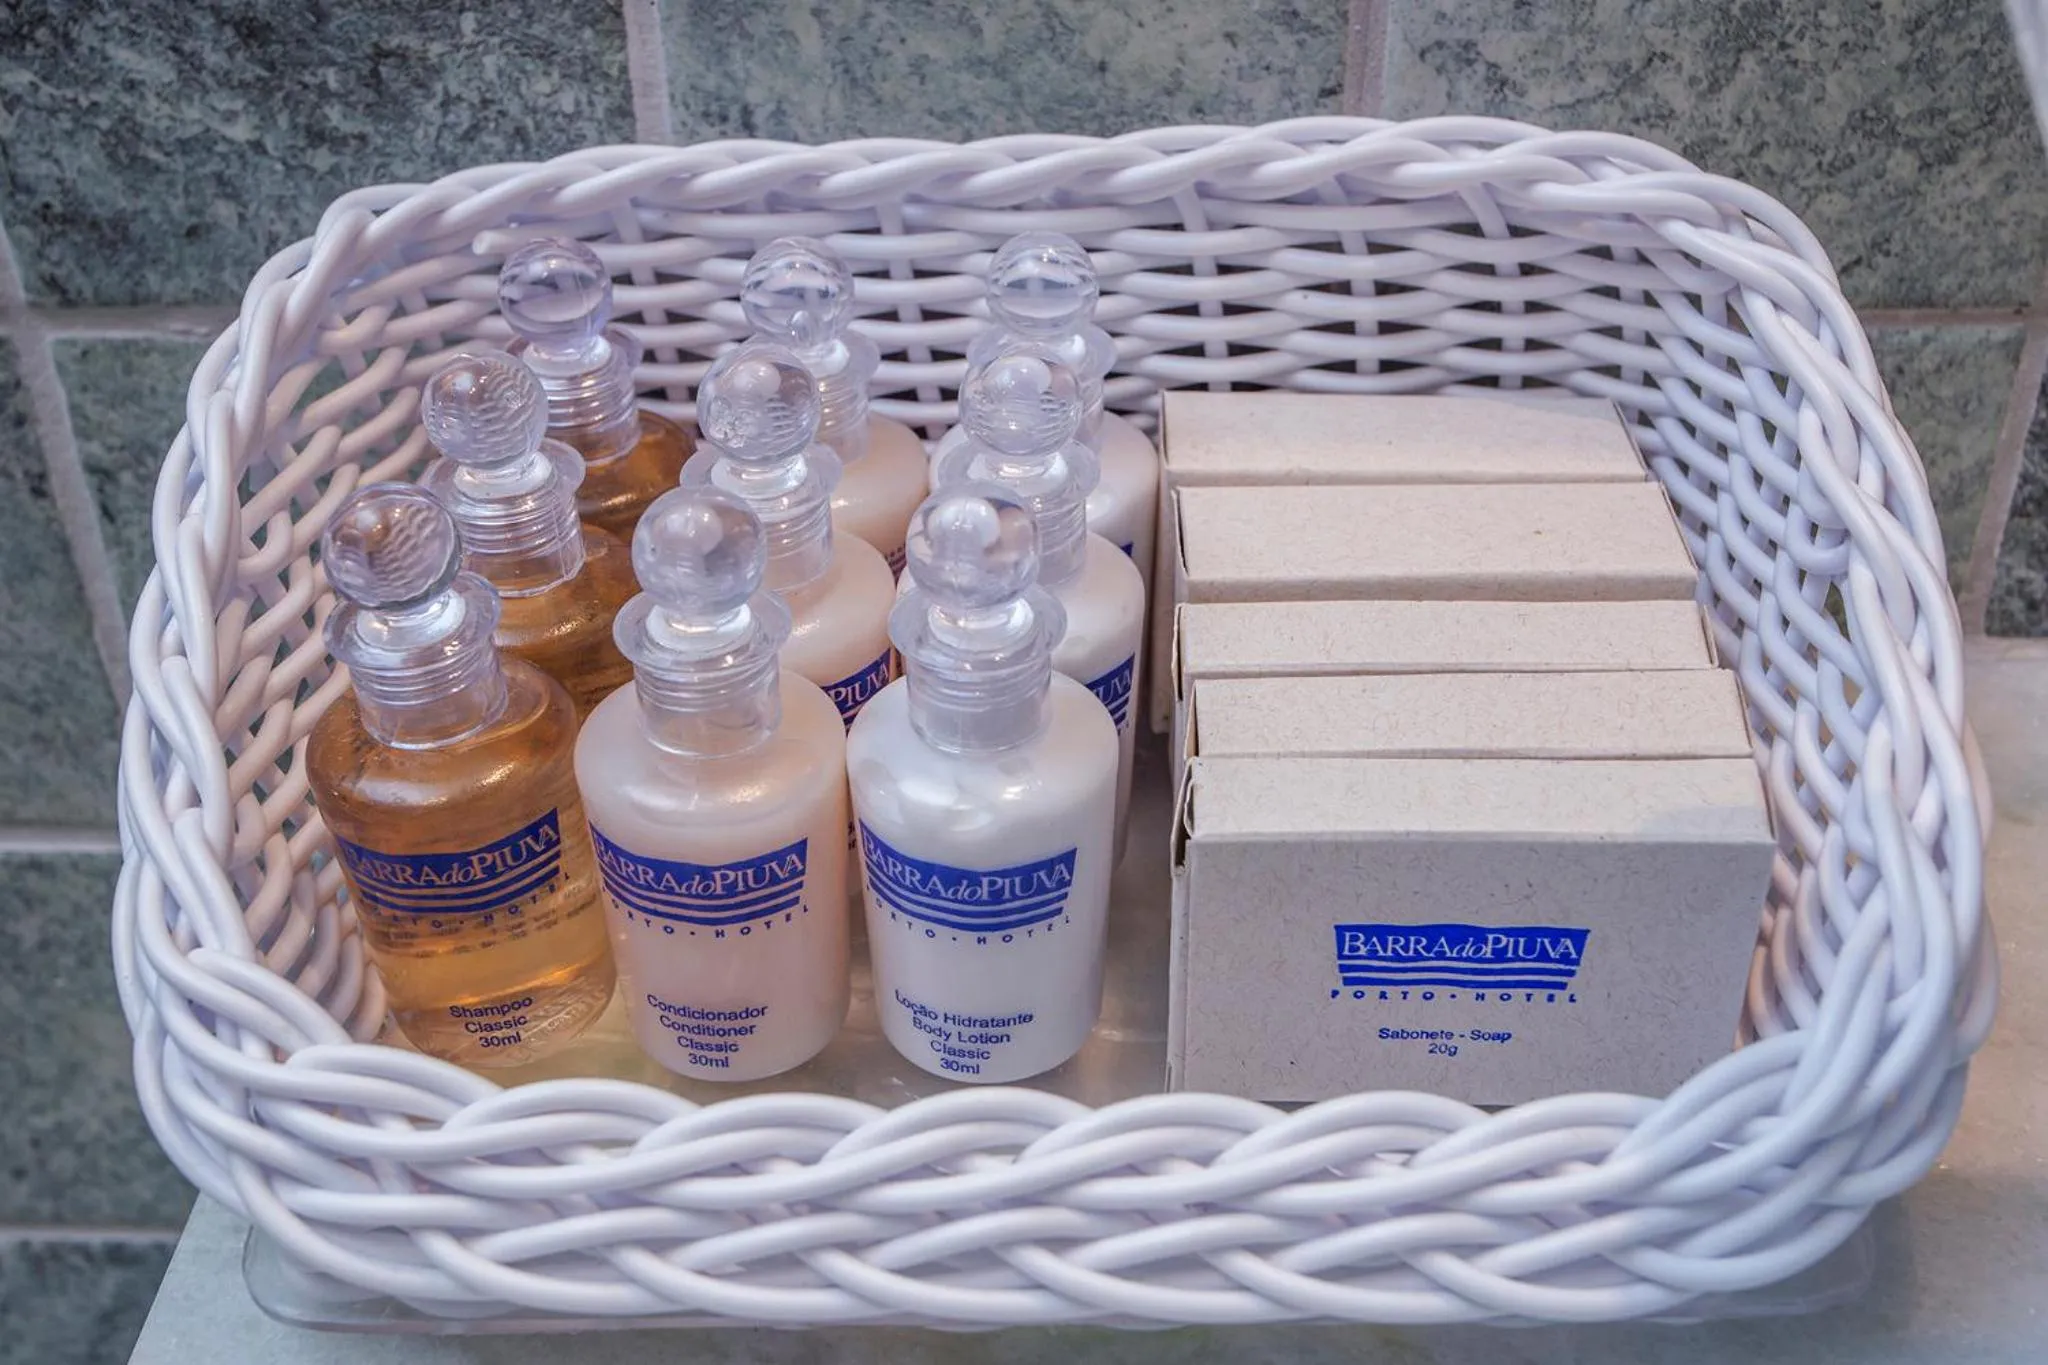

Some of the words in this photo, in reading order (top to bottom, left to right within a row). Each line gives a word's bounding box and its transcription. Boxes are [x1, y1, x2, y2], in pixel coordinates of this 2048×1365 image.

[1330, 989, 1435, 1001] PORTO
[1475, 991, 1577, 1003] HOTEL
[449, 997, 533, 1018] Shampoo
[646, 993, 768, 1021] Condicionador
[464, 1015, 528, 1034] Classic
[660, 1014, 757, 1037] Conditioner
[943, 1012, 1034, 1029] Hidratante
[479, 1031, 522, 1048] 30ml
[912, 1016, 952, 1042] Body
[957, 1031, 1011, 1045] Lotion
[1378, 1027, 1455, 1041] Sabonete
[1469, 1029, 1513, 1044] Soap
[677, 1035, 740, 1054] Classic
[930, 1039, 991, 1060] Classic
[1428, 1042, 1459, 1057] 20g
[688, 1052, 730, 1069] 30ml
[940, 1057, 980, 1074] 30ml
